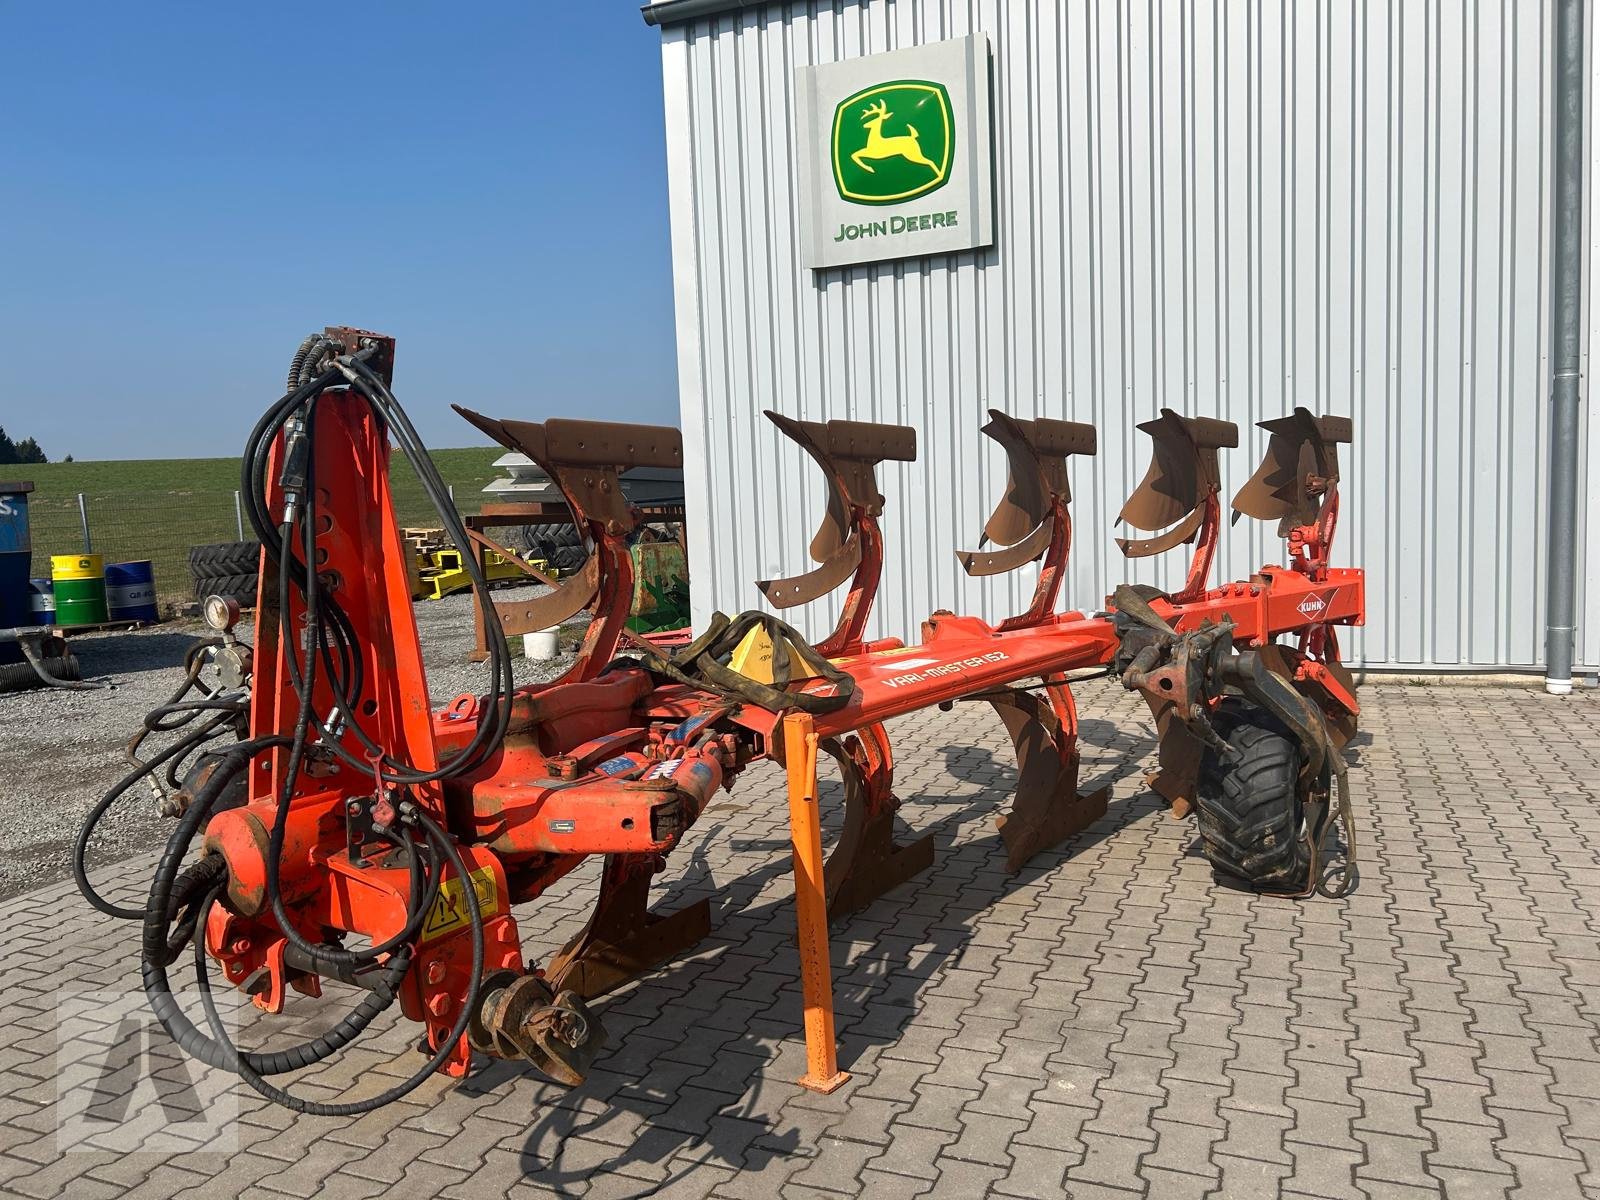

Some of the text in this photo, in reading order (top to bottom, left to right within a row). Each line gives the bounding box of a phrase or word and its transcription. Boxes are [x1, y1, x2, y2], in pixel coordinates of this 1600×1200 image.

[834, 210, 958, 242] JOHN DEERE
[1301, 601, 1322, 612] KUHN
[881, 657, 985, 688] VARI-MASTER
[982, 651, 1010, 664] 152
